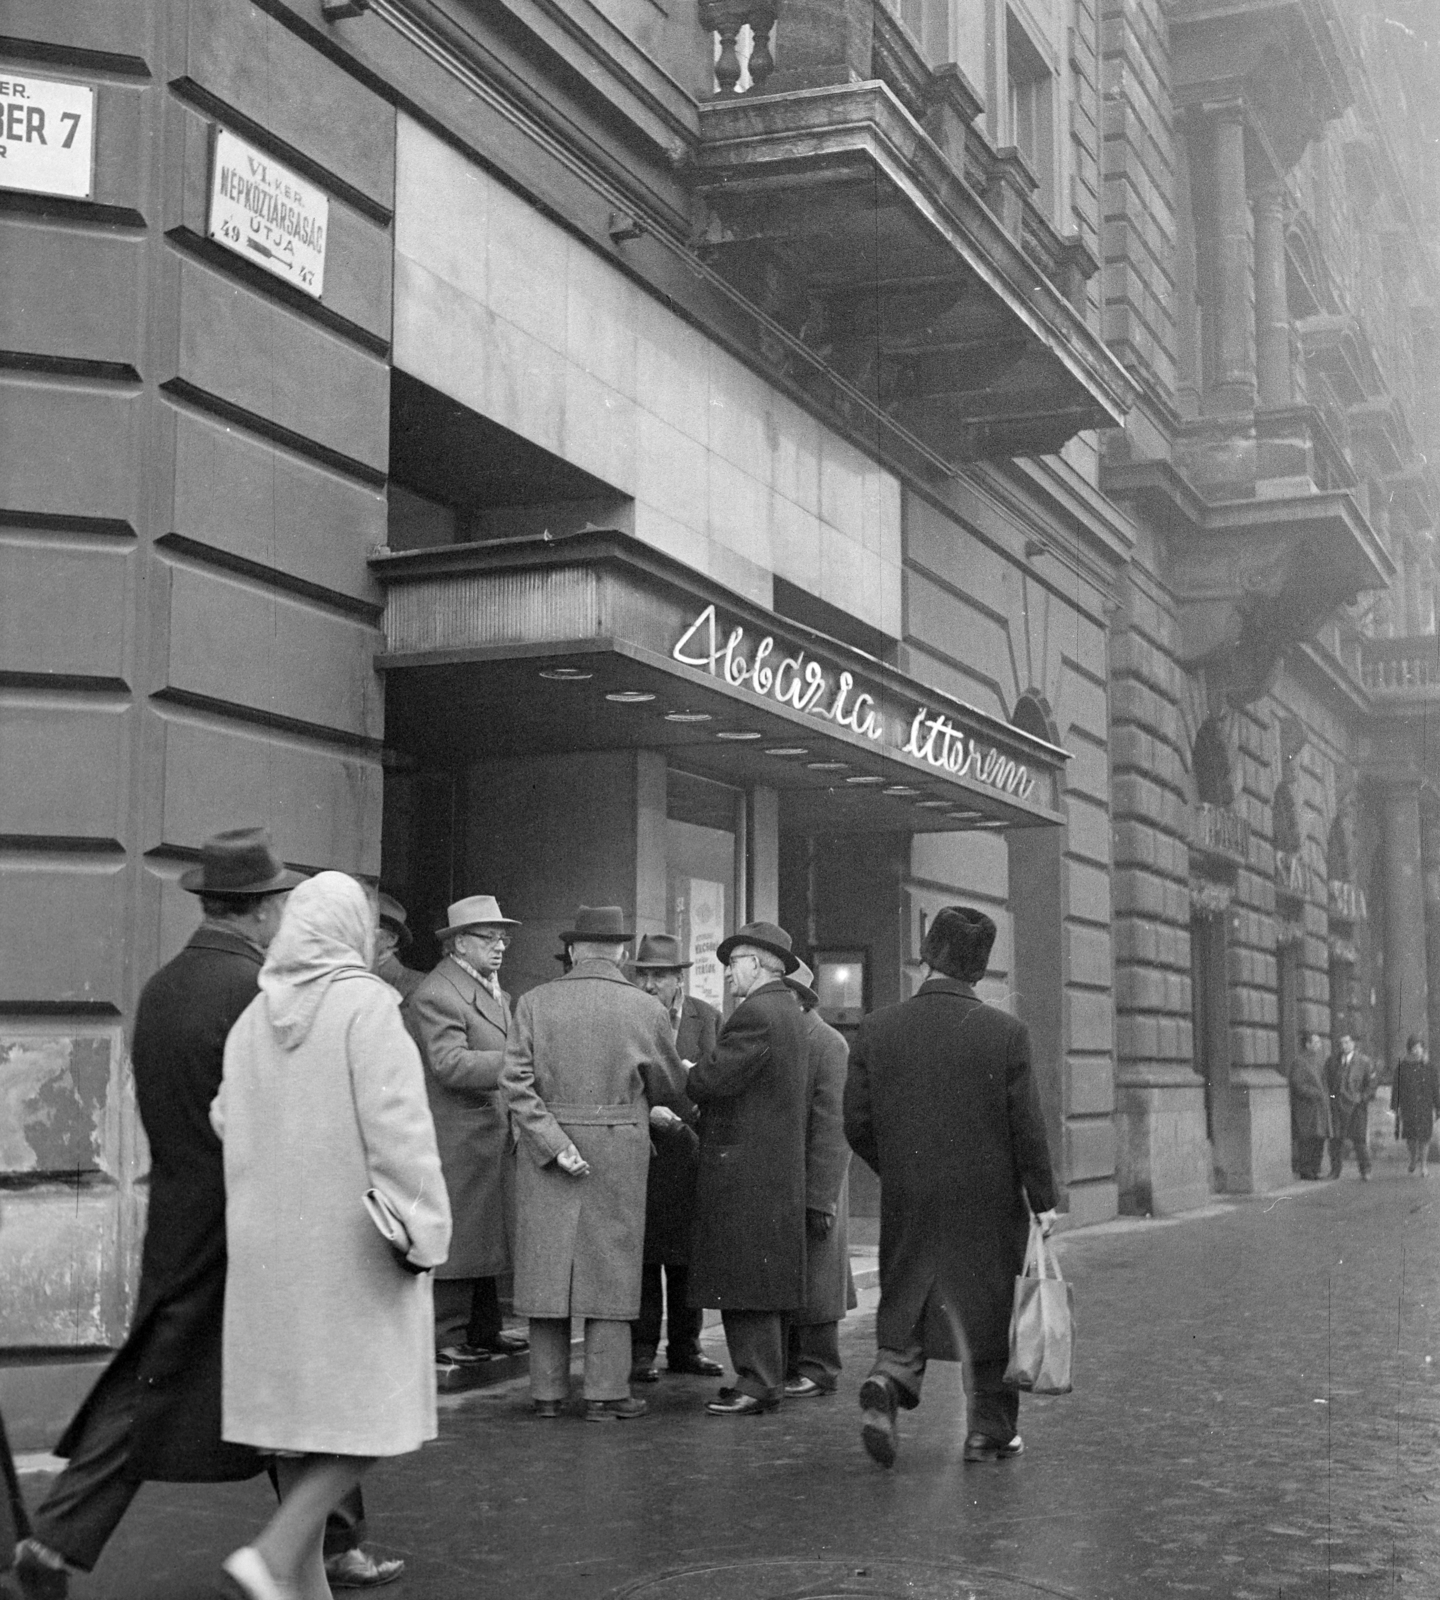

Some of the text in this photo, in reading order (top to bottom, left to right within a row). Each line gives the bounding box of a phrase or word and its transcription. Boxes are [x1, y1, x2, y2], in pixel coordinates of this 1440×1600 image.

[0, 81, 31, 99] ER.
[0, 102, 82, 149] ER 7
[247, 155, 306, 208] VI. KER.
[220, 219, 316, 286] 49 47
